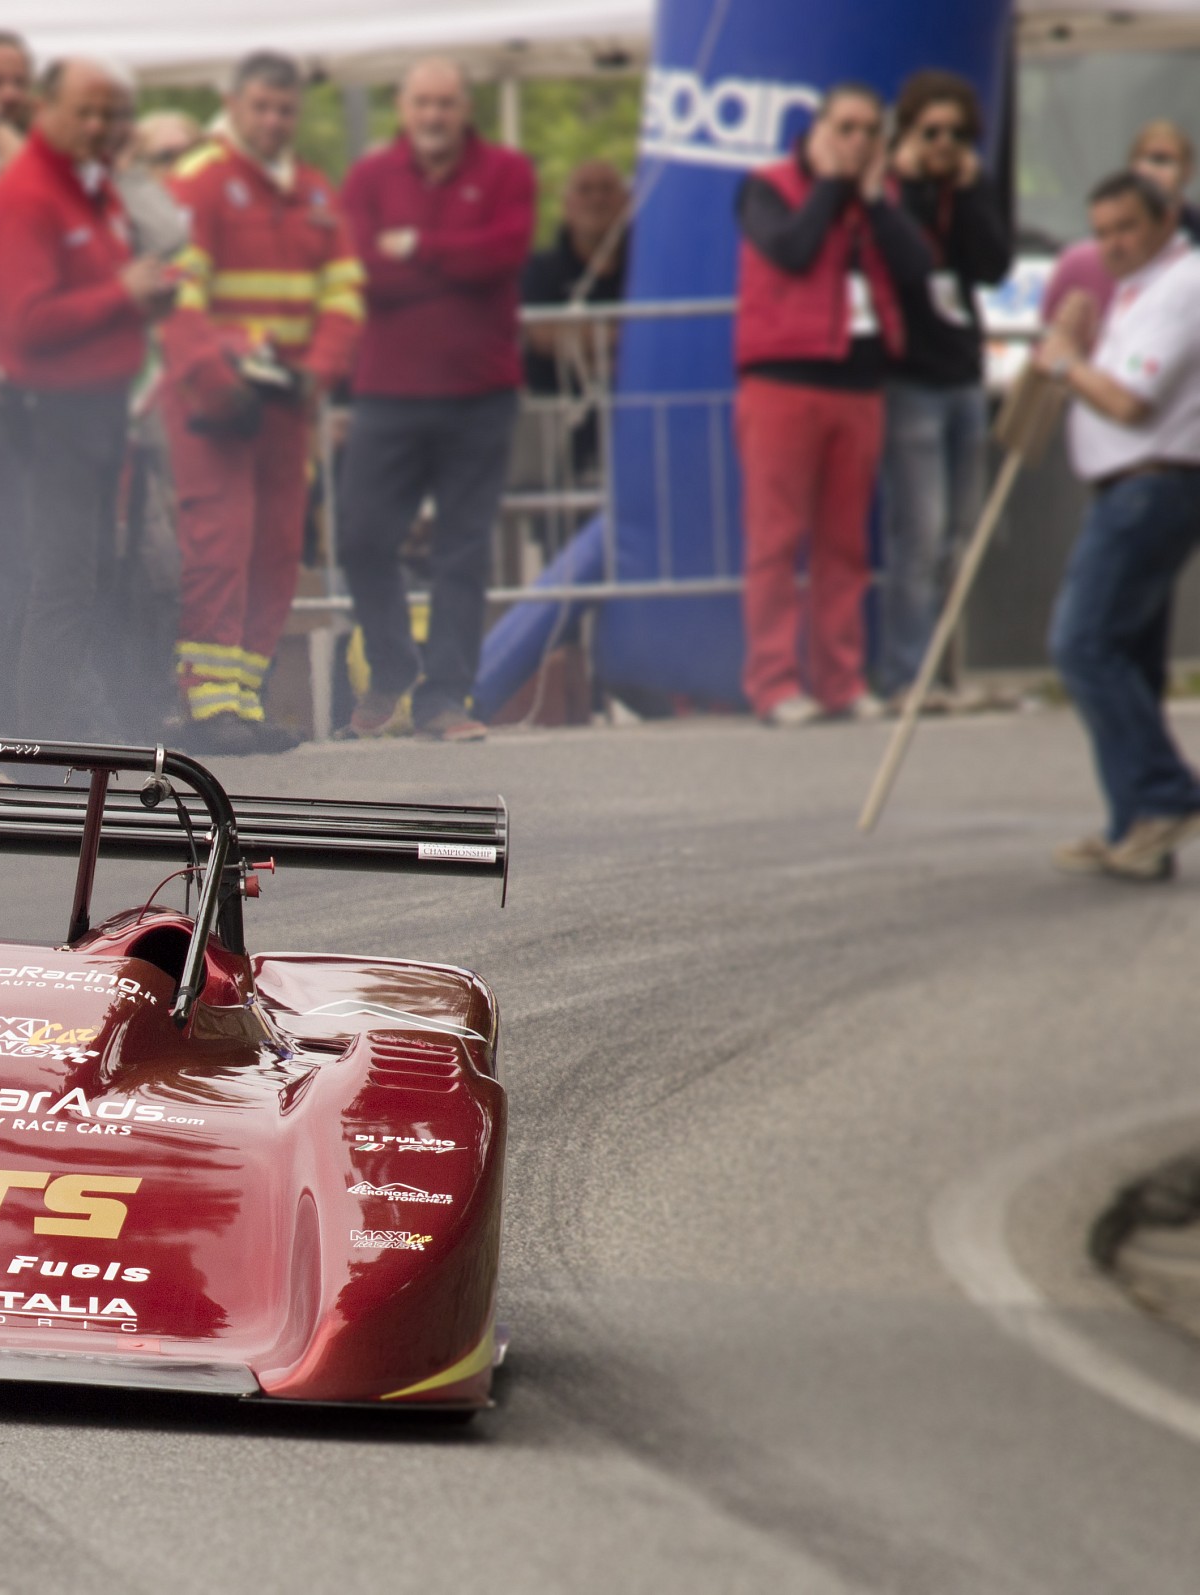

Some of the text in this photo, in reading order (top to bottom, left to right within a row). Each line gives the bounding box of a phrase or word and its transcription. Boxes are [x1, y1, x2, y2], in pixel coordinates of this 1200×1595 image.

[423, 848, 492, 858] CHAMPIONSHIP
[1, 980, 47, 988] AUTO
[54, 982, 76, 991] DA
[83, 985, 137, 1004] CORSA
[28, 1023, 100, 1045] Car
[11, 1118, 66, 1133] RACE
[77, 1123, 132, 1136] CARS
[382, 1135, 456, 1146] FULVIO
[358, 1190, 453, 1200] CRONOSCALATE
[387, 1196, 453, 1205] STORICHE.IT
[350, 1229, 411, 1242] MAXI
[6, 1255, 151, 1283] Fuels
